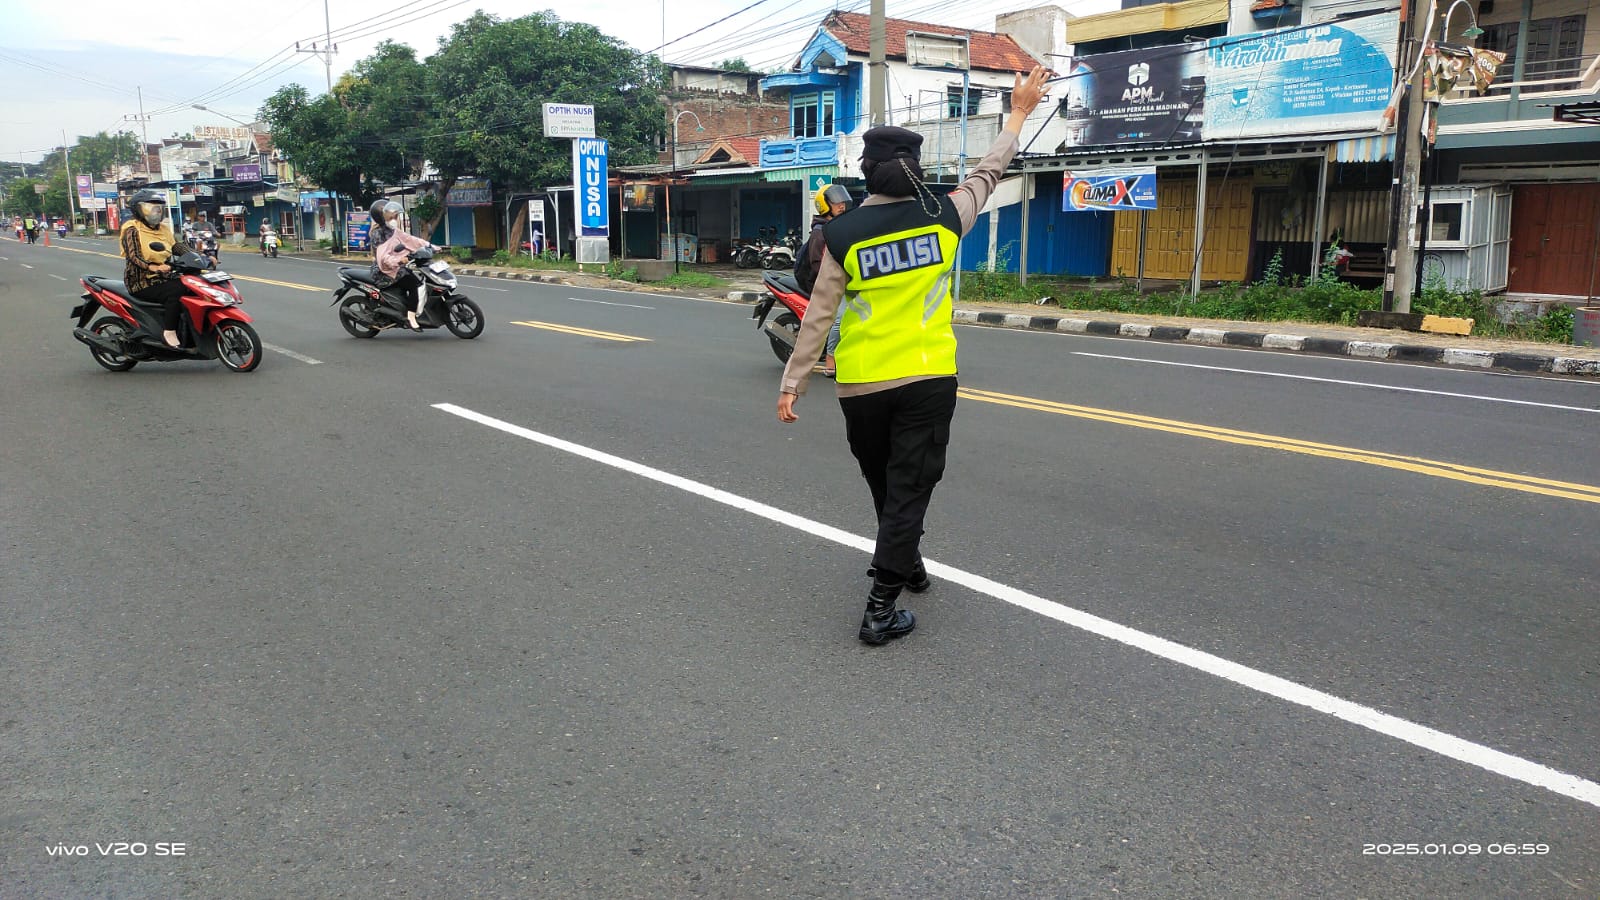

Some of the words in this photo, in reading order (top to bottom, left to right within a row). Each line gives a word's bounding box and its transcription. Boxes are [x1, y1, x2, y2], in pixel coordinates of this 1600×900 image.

[1305, 26, 1331, 38] PLUS
[1121, 86, 1154, 101] APM
[549, 106, 571, 115] OPTIK
[573, 107, 593, 115] NUSA
[1099, 107, 1126, 115] AMANAH
[1127, 105, 1155, 113] PERKASA
[580, 140, 606, 156] OPTIK
[586, 157, 601, 217] NUSA
[1071, 177, 1142, 209] CLIMAX
[859, 234, 942, 278] POLISI
